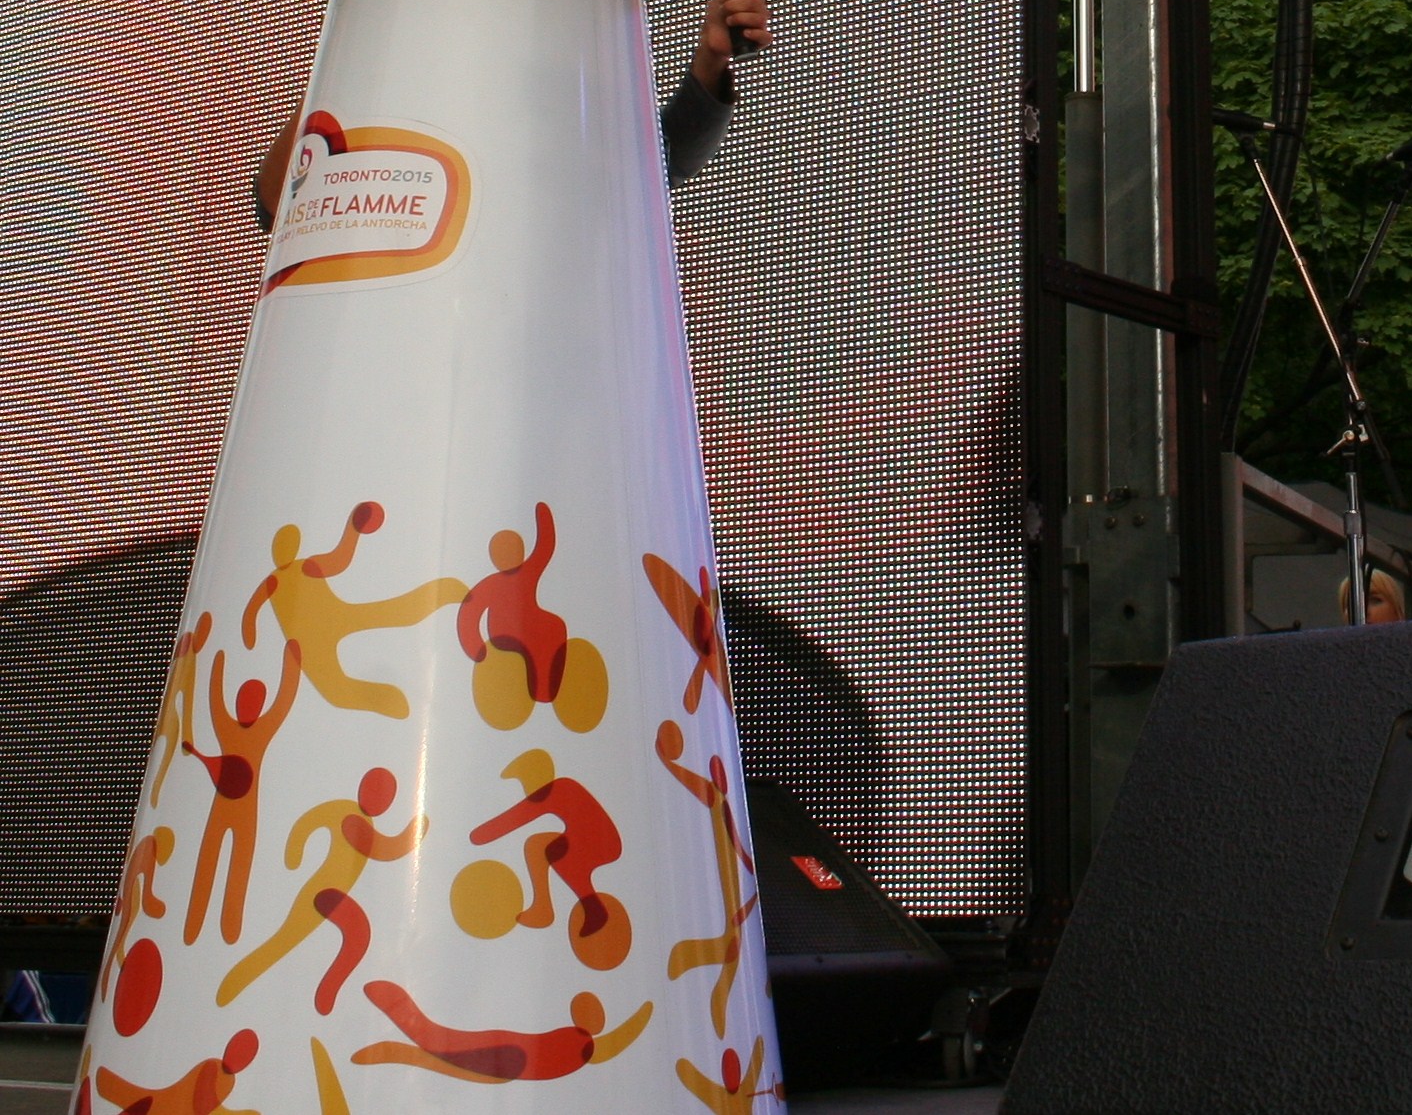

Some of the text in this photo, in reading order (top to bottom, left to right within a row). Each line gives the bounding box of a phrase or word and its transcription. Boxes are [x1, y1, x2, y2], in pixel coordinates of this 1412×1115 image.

[323, 169, 433, 185] TORONTO2015
[320, 194, 428, 217] FLAMME
[329, 219, 344, 230] DE
[345, 219, 358, 229] LA
[360, 218, 428, 230] ANTORCHA
